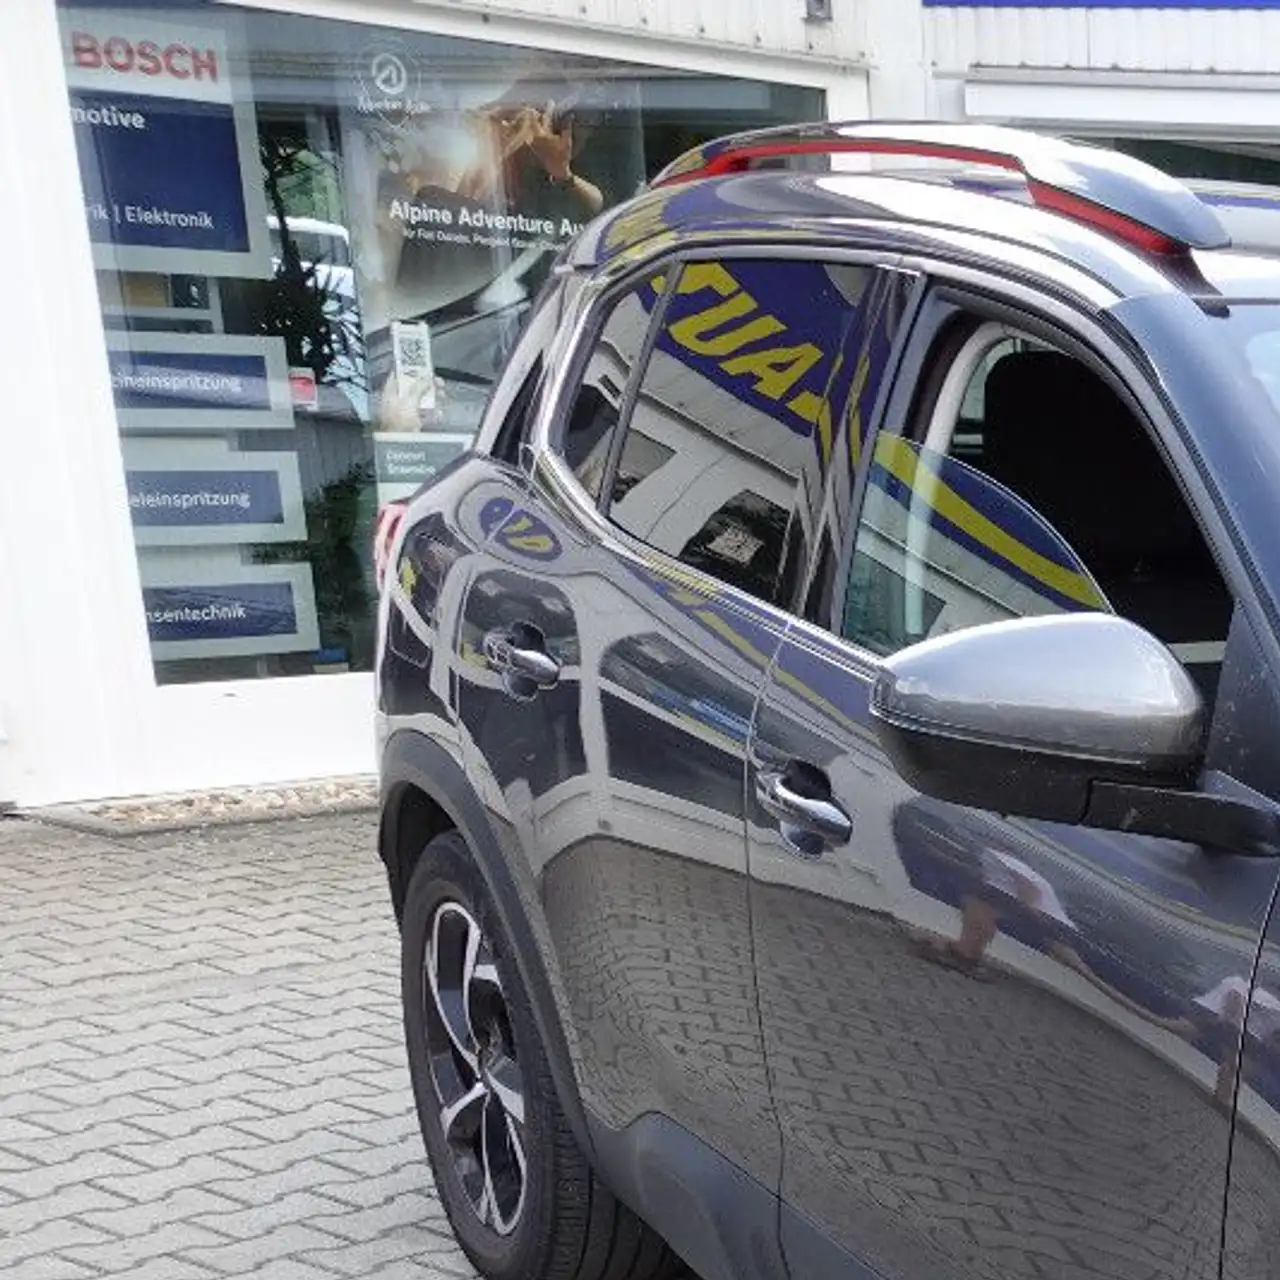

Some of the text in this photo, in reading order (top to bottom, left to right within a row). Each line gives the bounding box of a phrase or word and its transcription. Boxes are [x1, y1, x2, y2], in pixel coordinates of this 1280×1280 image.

[72, 30, 218, 83] BOSCH
[125, 206, 214, 229] Elektronik
[389, 199, 452, 225] Alpine
[458, 207, 554, 235] Adventure
